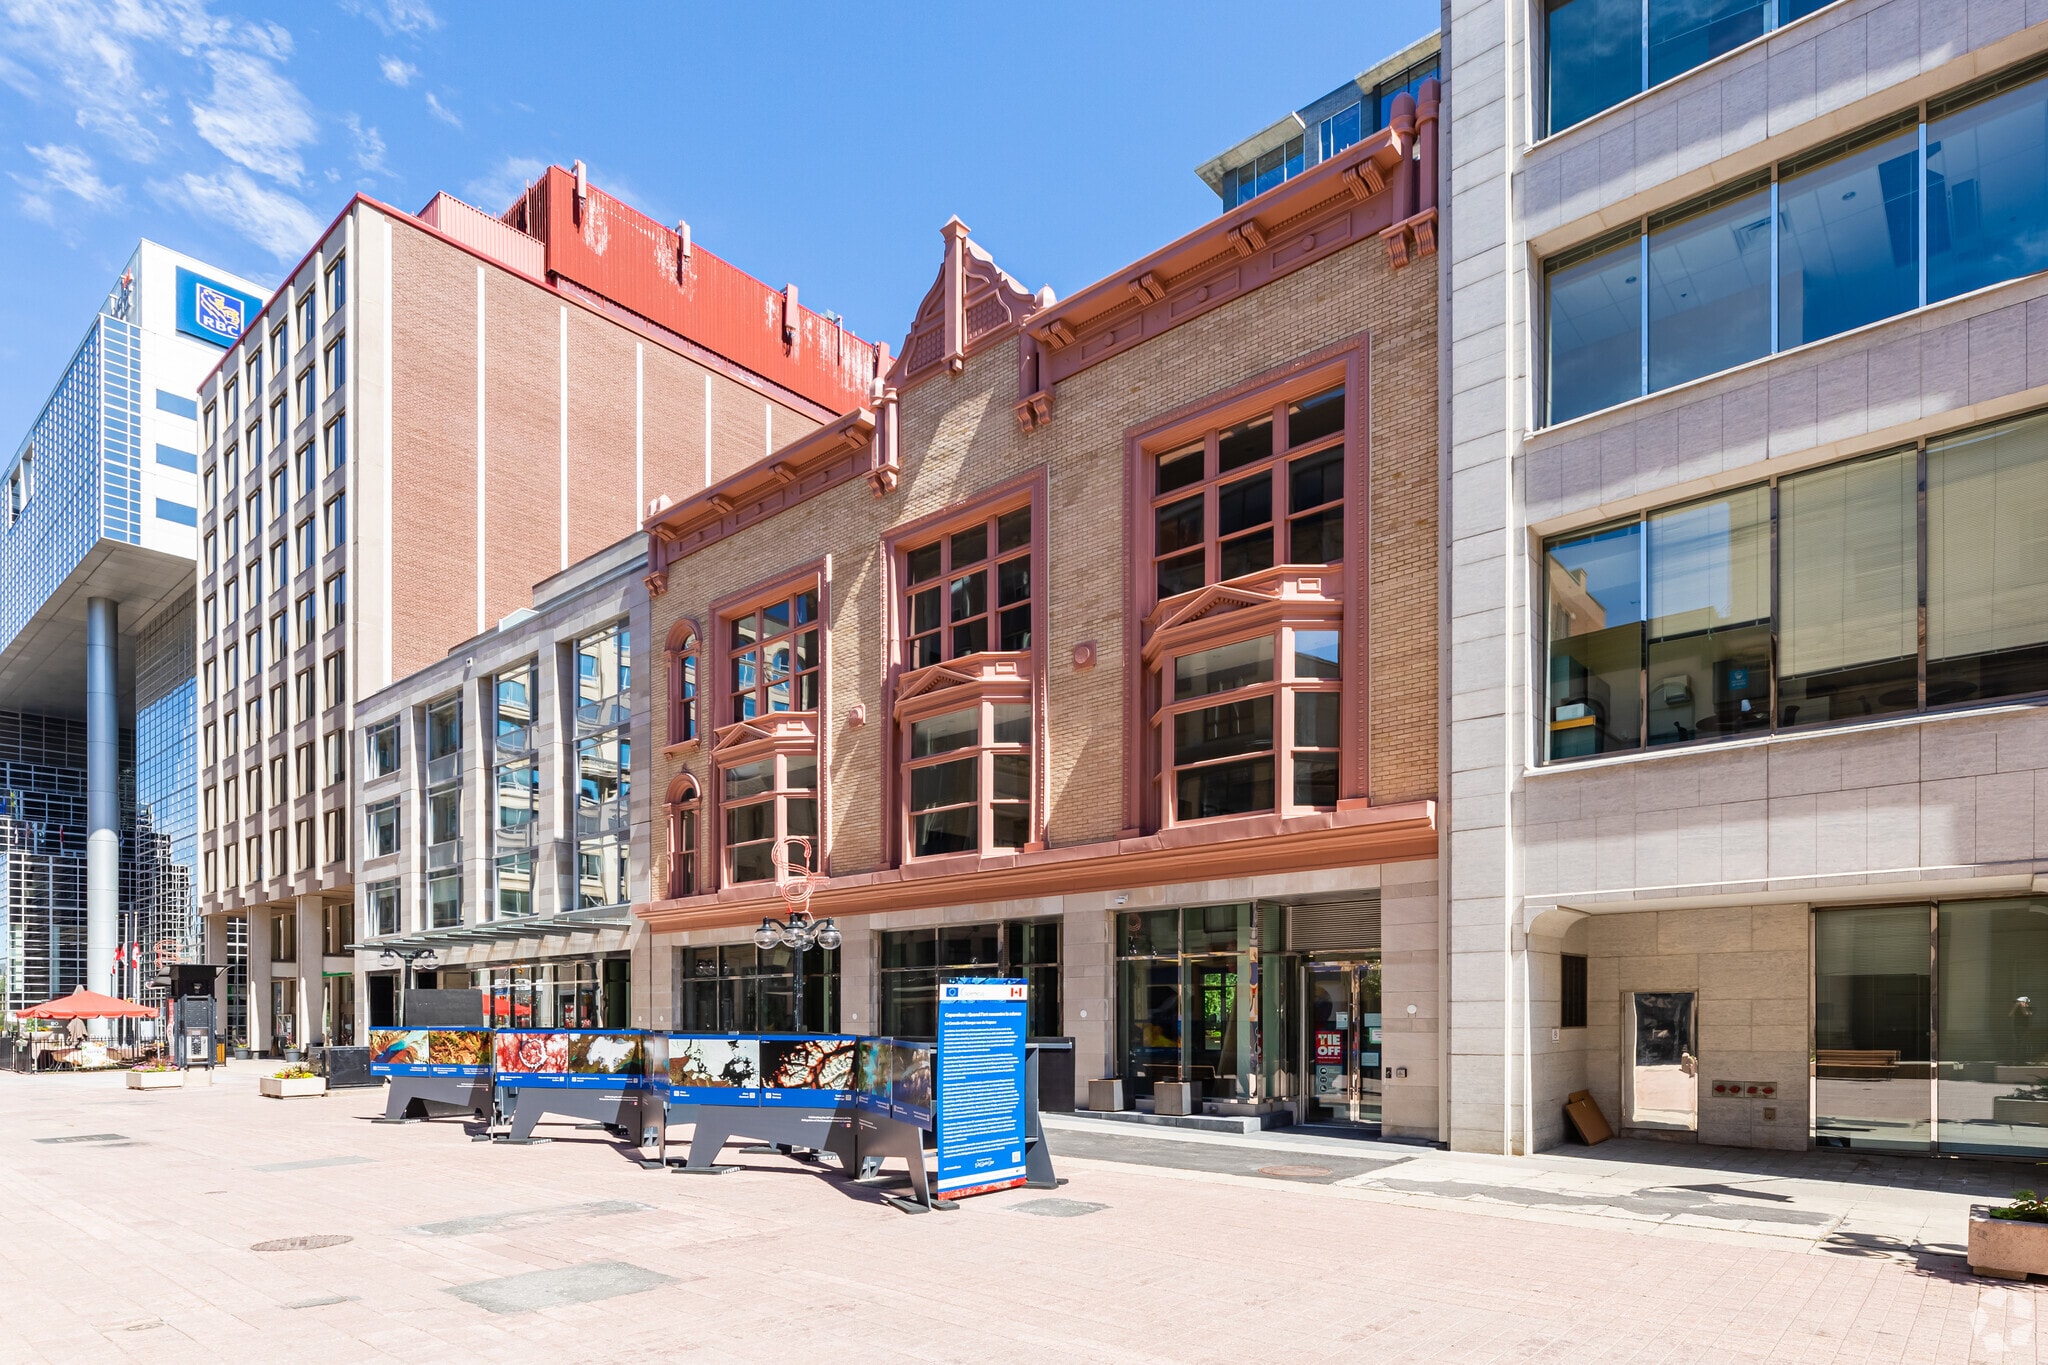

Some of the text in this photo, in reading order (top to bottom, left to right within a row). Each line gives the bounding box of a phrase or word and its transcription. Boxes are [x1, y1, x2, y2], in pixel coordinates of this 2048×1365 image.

[203, 315, 239, 337] RBC
[1318, 1034, 1341, 1045] TIE
[1317, 1046, 1341, 1055] OFF
